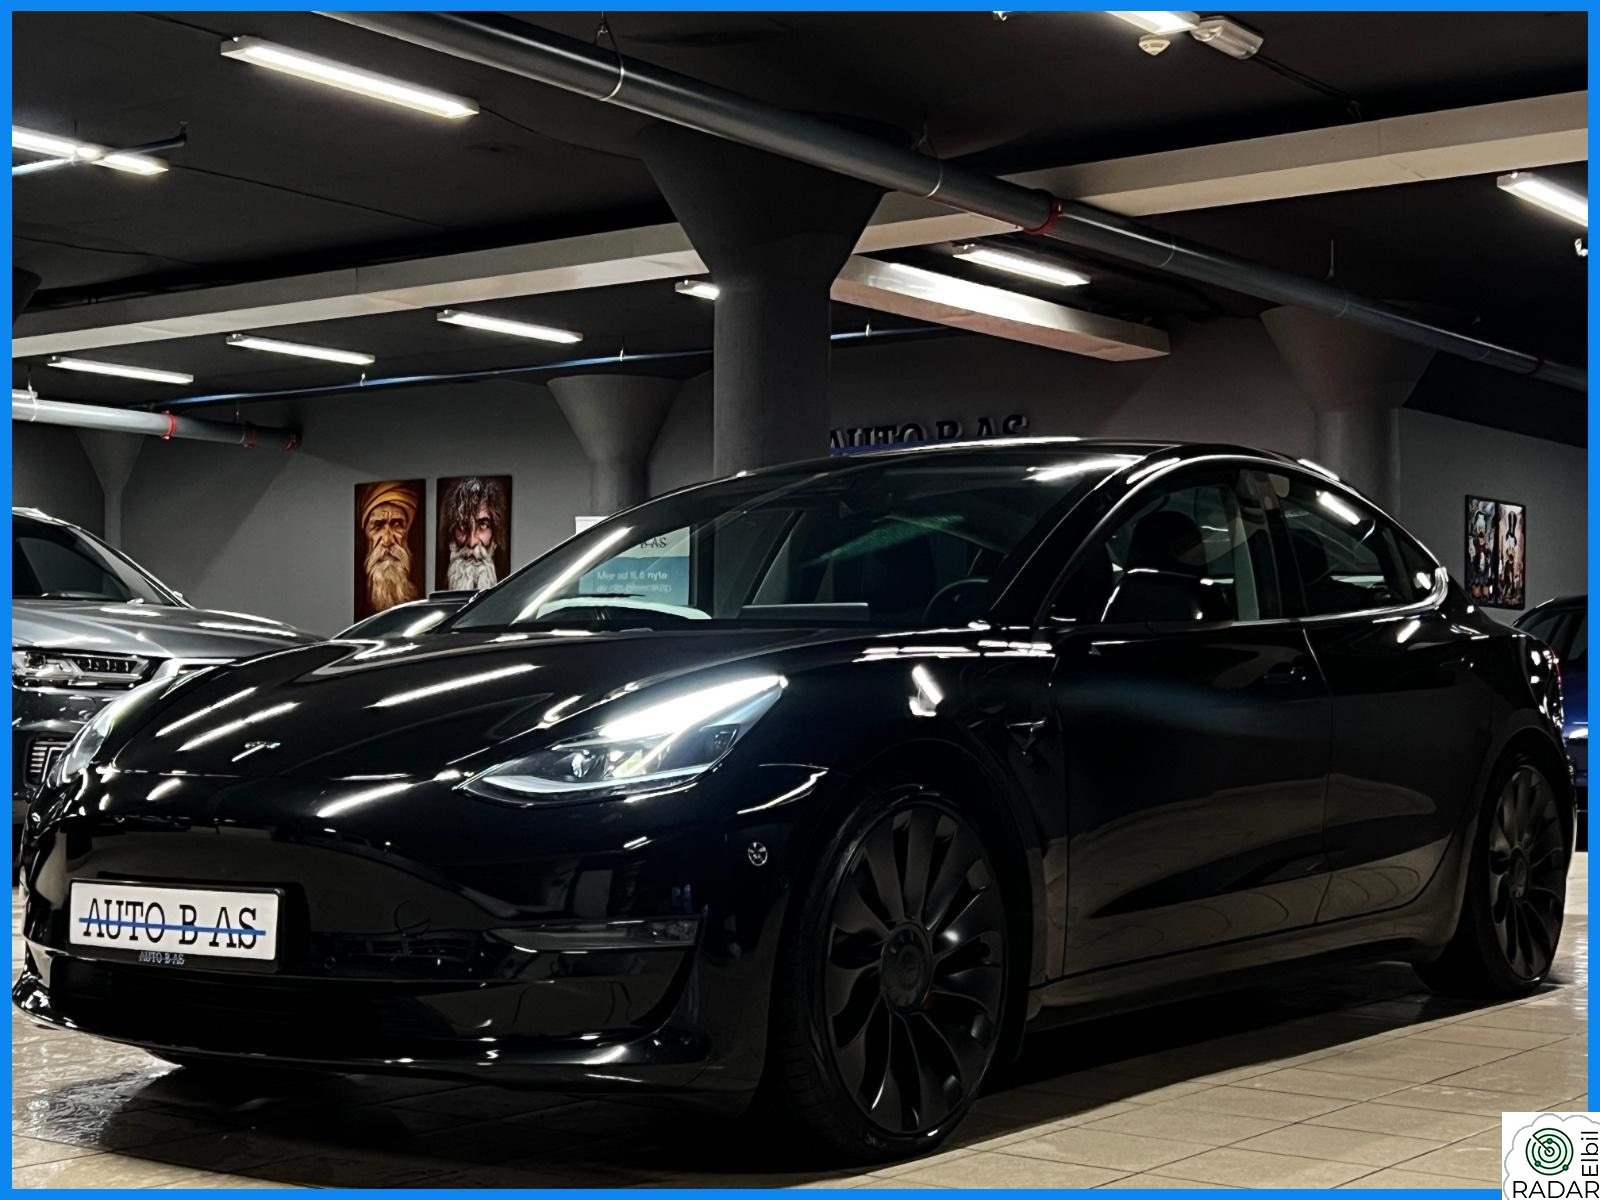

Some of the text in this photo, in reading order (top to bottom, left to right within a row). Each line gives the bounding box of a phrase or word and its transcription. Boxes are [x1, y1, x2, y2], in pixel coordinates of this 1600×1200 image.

[829, 423, 925, 456] AUTO
[650, 537, 667, 549] AS
[83, 898, 258, 949] AUTO B AS
[138, 951, 185, 965] AUTO B AS
